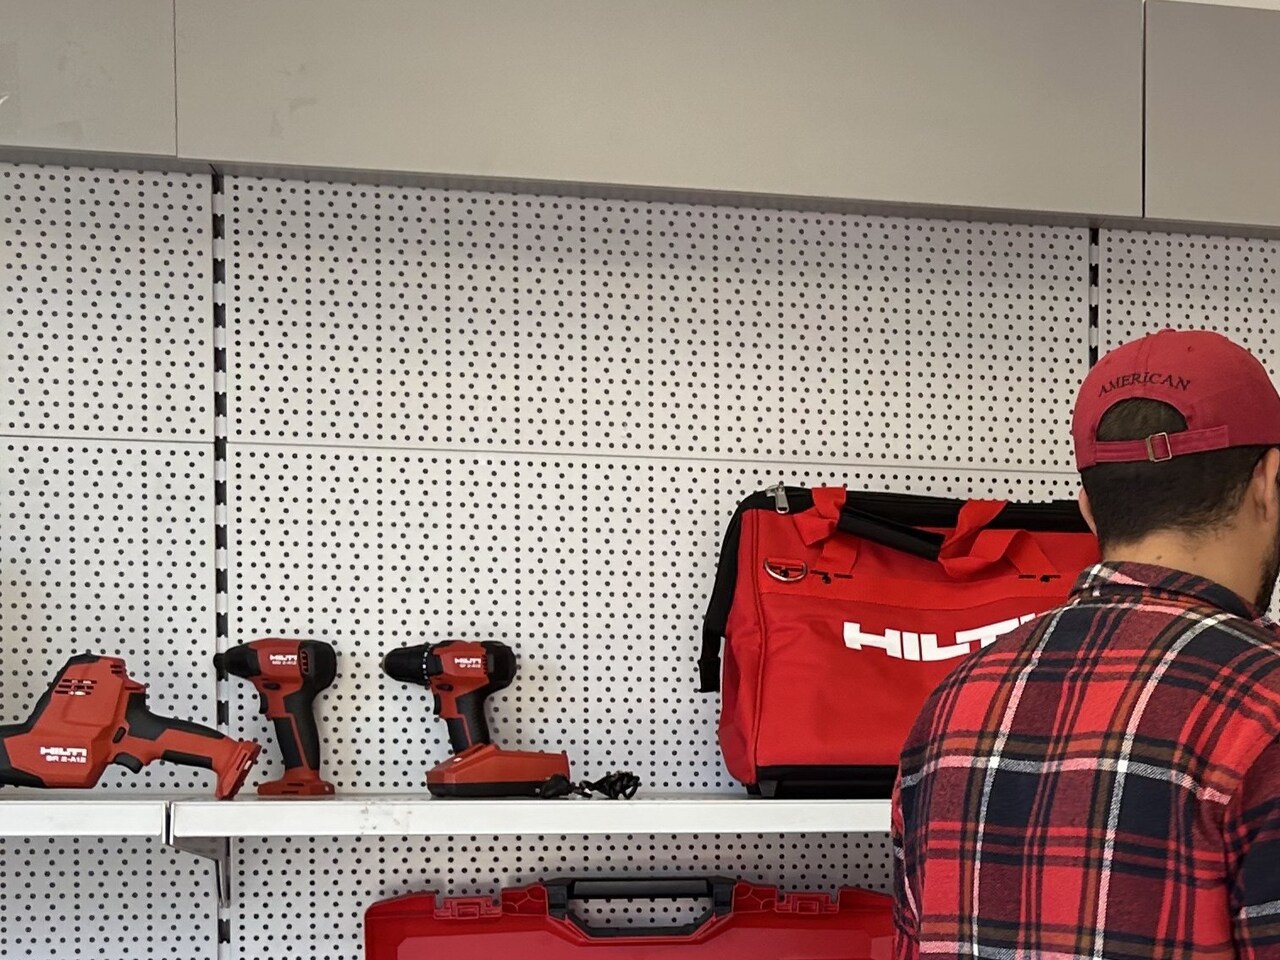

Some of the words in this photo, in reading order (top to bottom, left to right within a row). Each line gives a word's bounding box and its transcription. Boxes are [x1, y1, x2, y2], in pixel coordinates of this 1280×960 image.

[1098, 371, 1190, 397] AMERICAN
[454, 657, 482, 665] HILTI
[40, 747, 87, 757] HILTI
[45, 755, 59, 763] SR
[61, 756, 87, 764] 2-A12
